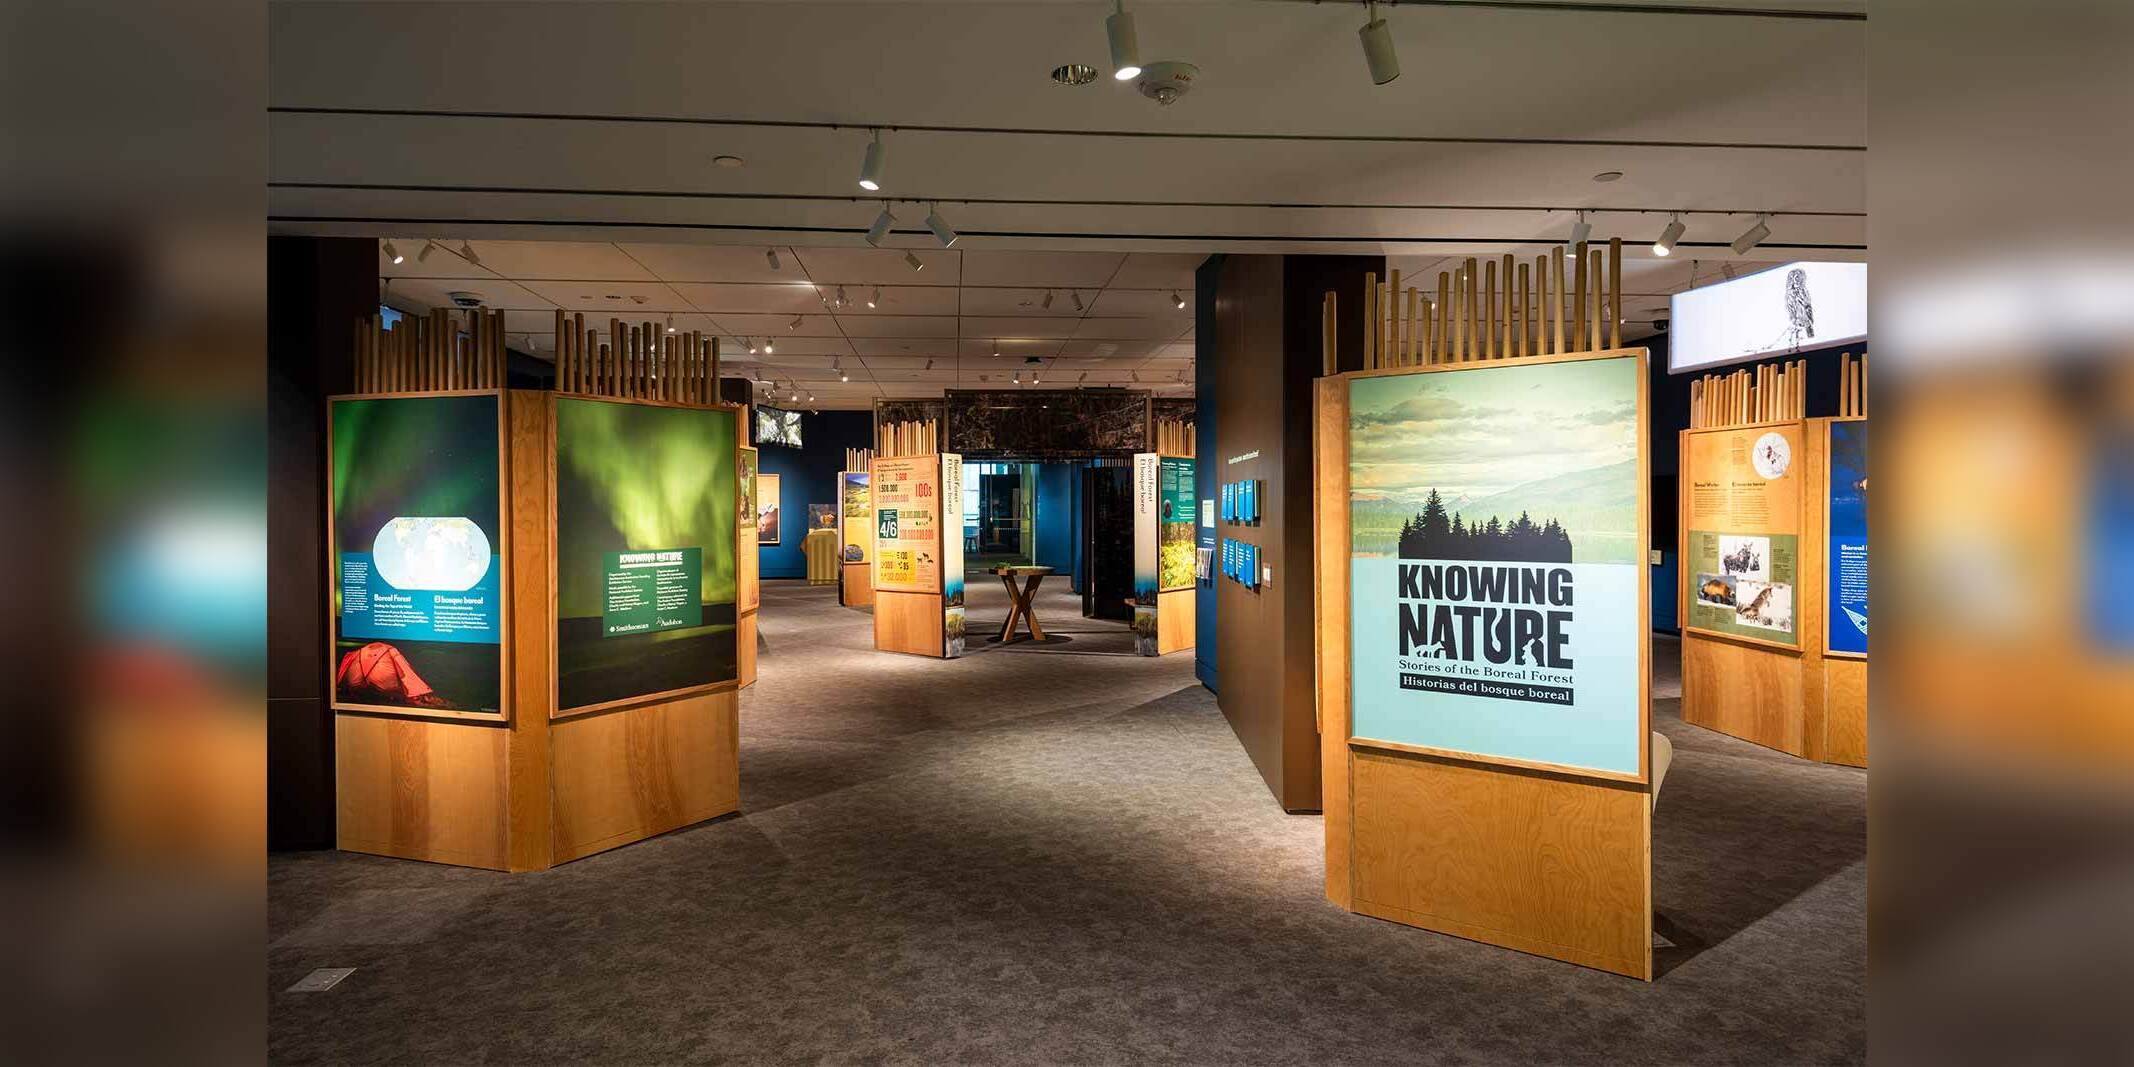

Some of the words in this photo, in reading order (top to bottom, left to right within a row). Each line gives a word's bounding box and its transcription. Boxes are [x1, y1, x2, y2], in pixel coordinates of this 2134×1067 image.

[880, 520, 897, 538] 4/6
[620, 553, 656, 564] KNOWING
[656, 551, 683, 562] NATURE
[1398, 564, 1574, 607] KNOWING
[374, 594, 393, 602] Boreal
[394, 594, 412, 602] Forest
[441, 596, 463, 605] bosque
[463, 596, 484, 605] boreal
[616, 624, 649, 632] Smithsonian
[1398, 602, 1574, 670] NATURE
[1399, 659, 1441, 672] Stories
[1444, 664, 1457, 674] of
[1460, 665, 1480, 676] the
[1483, 666, 1527, 680] Boreal
[1529, 671, 1574, 684] Forest
[1403, 675, 1456, 690] Historias
[1459, 682, 1477, 692] del
[1481, 682, 1525, 698] bosque
[1528, 687, 1570, 701] boreal
